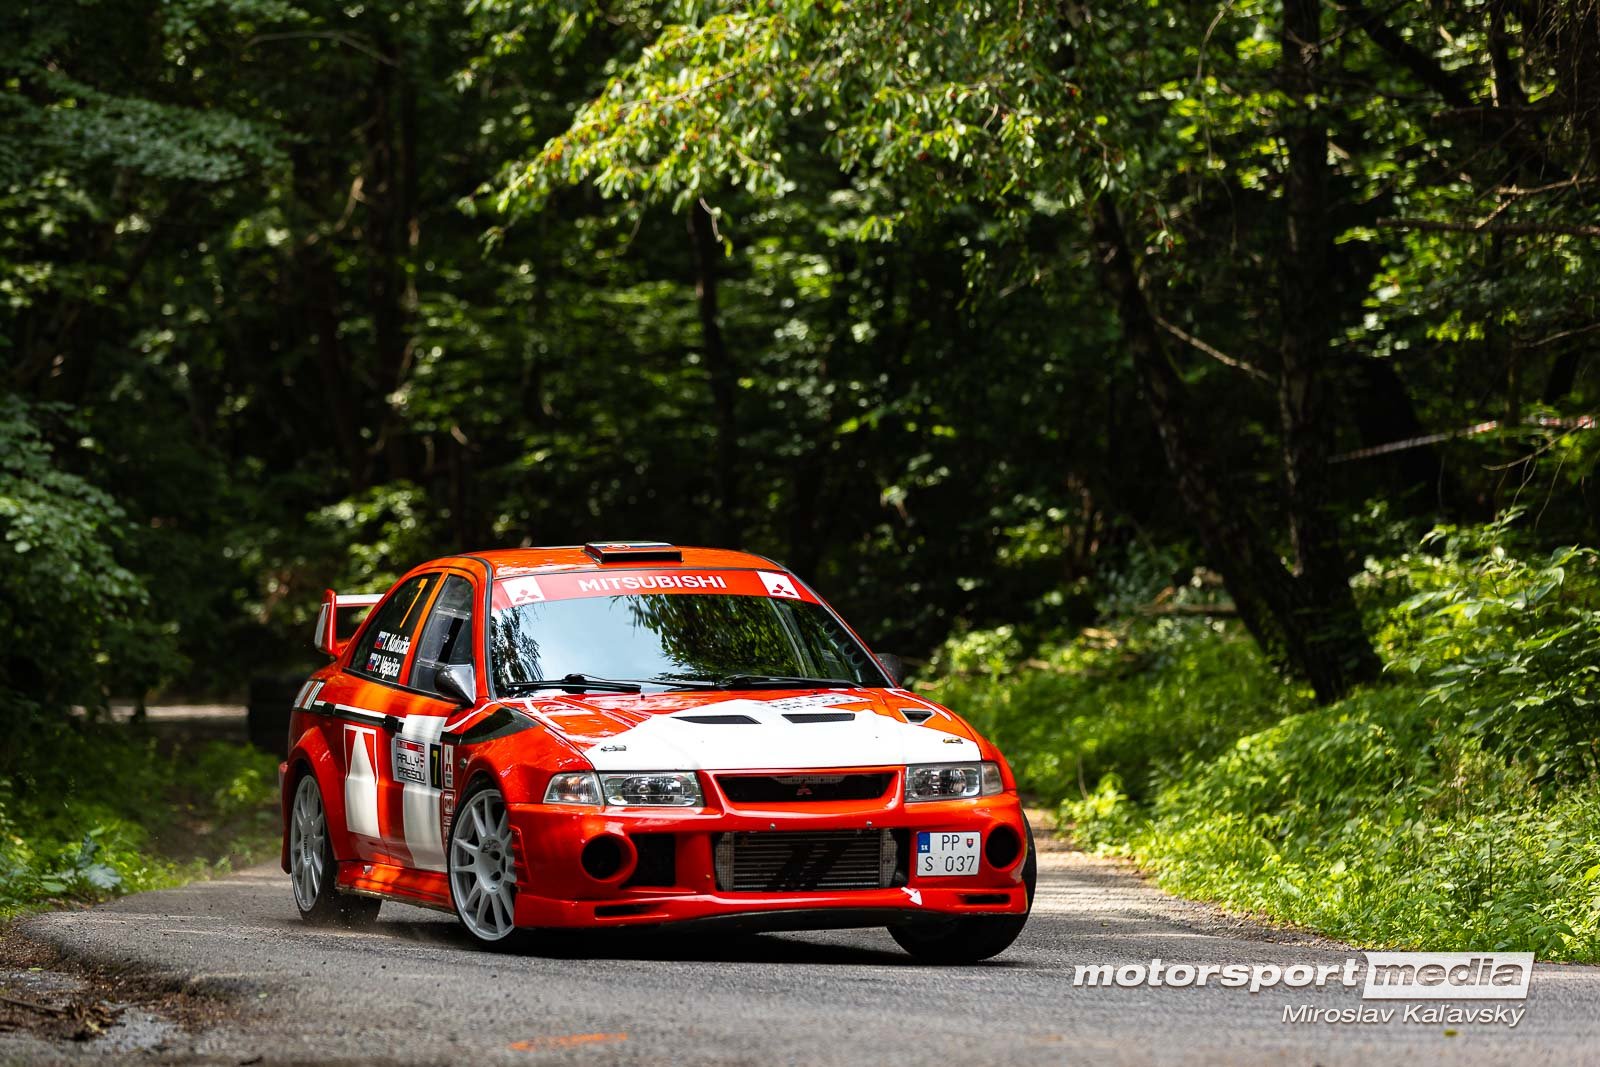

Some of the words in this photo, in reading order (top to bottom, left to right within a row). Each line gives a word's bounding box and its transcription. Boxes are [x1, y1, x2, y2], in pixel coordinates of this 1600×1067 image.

[577, 575, 728, 593] MITSUBISHI
[373, 654, 382, 672] P.
[397, 753, 420, 767] RALLY
[432, 750, 439, 785] 7
[941, 834, 960, 851] PP
[924, 856, 934, 872] S
[945, 855, 975, 873] 037
